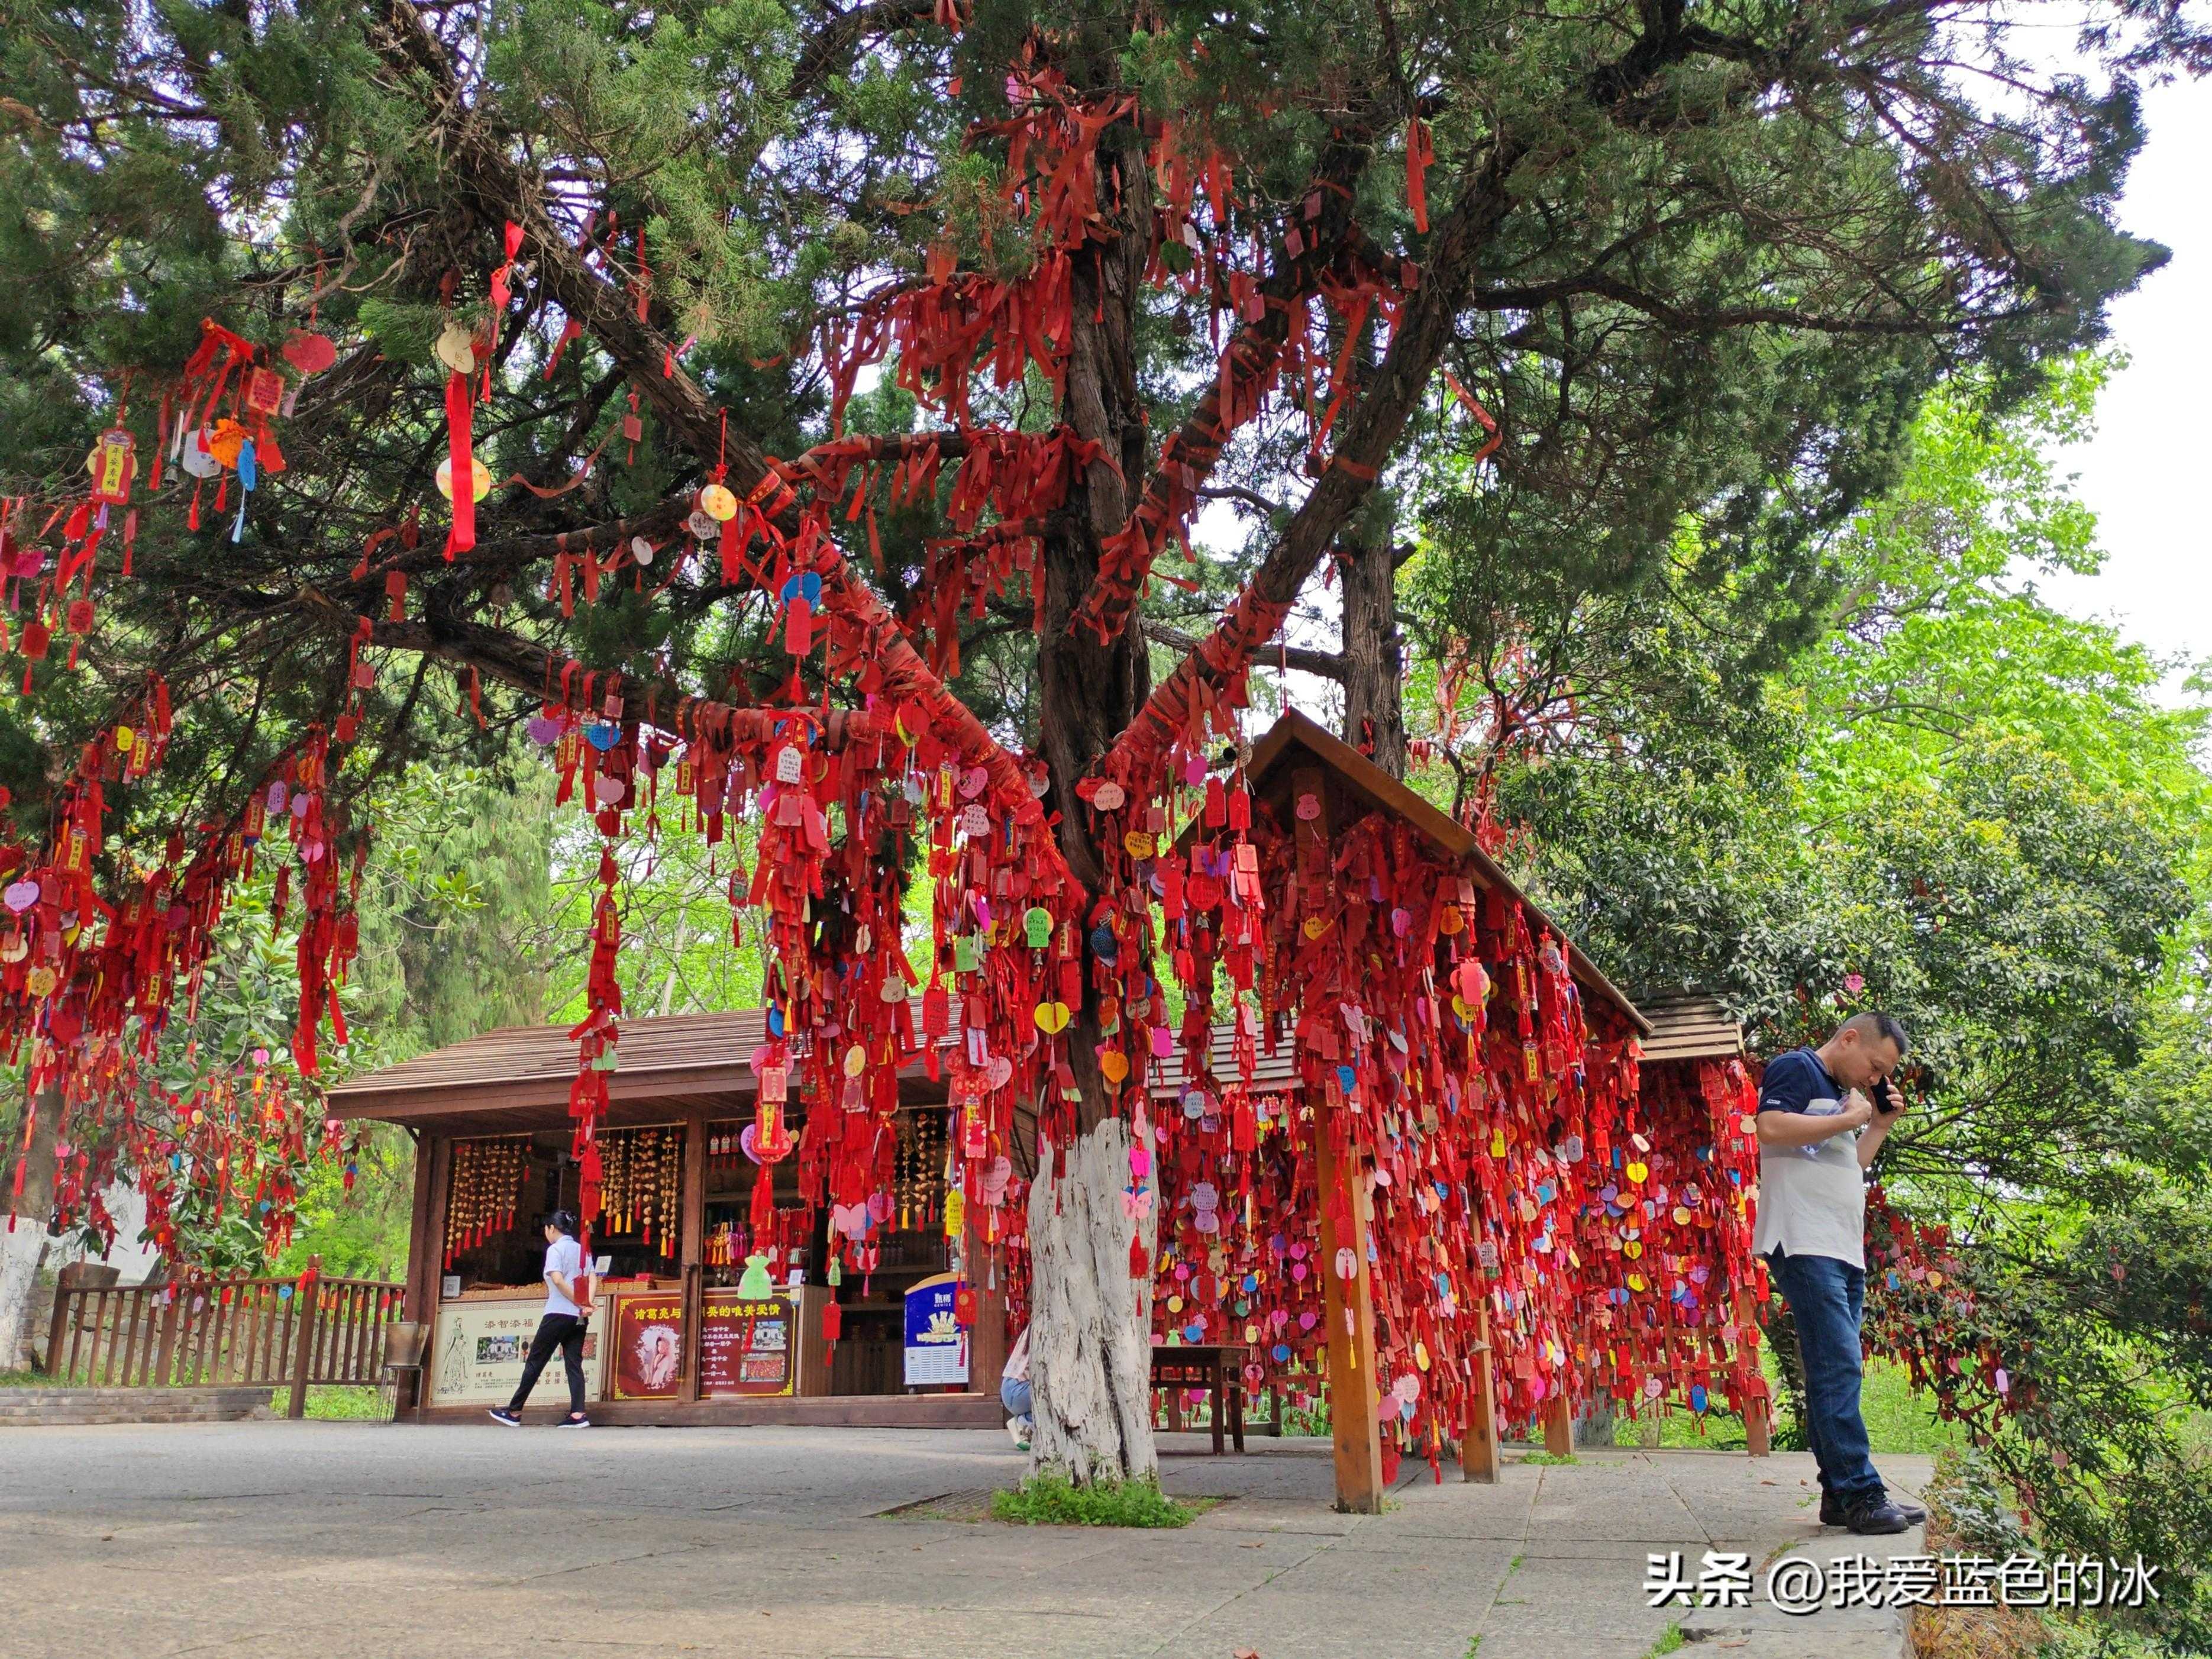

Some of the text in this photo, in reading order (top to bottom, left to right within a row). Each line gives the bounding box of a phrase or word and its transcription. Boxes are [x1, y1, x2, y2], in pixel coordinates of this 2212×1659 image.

[634, 1303, 780, 1321] 诸葛亮与英的唯美爱情
[484, 1318, 534, 1329] 添智添福
